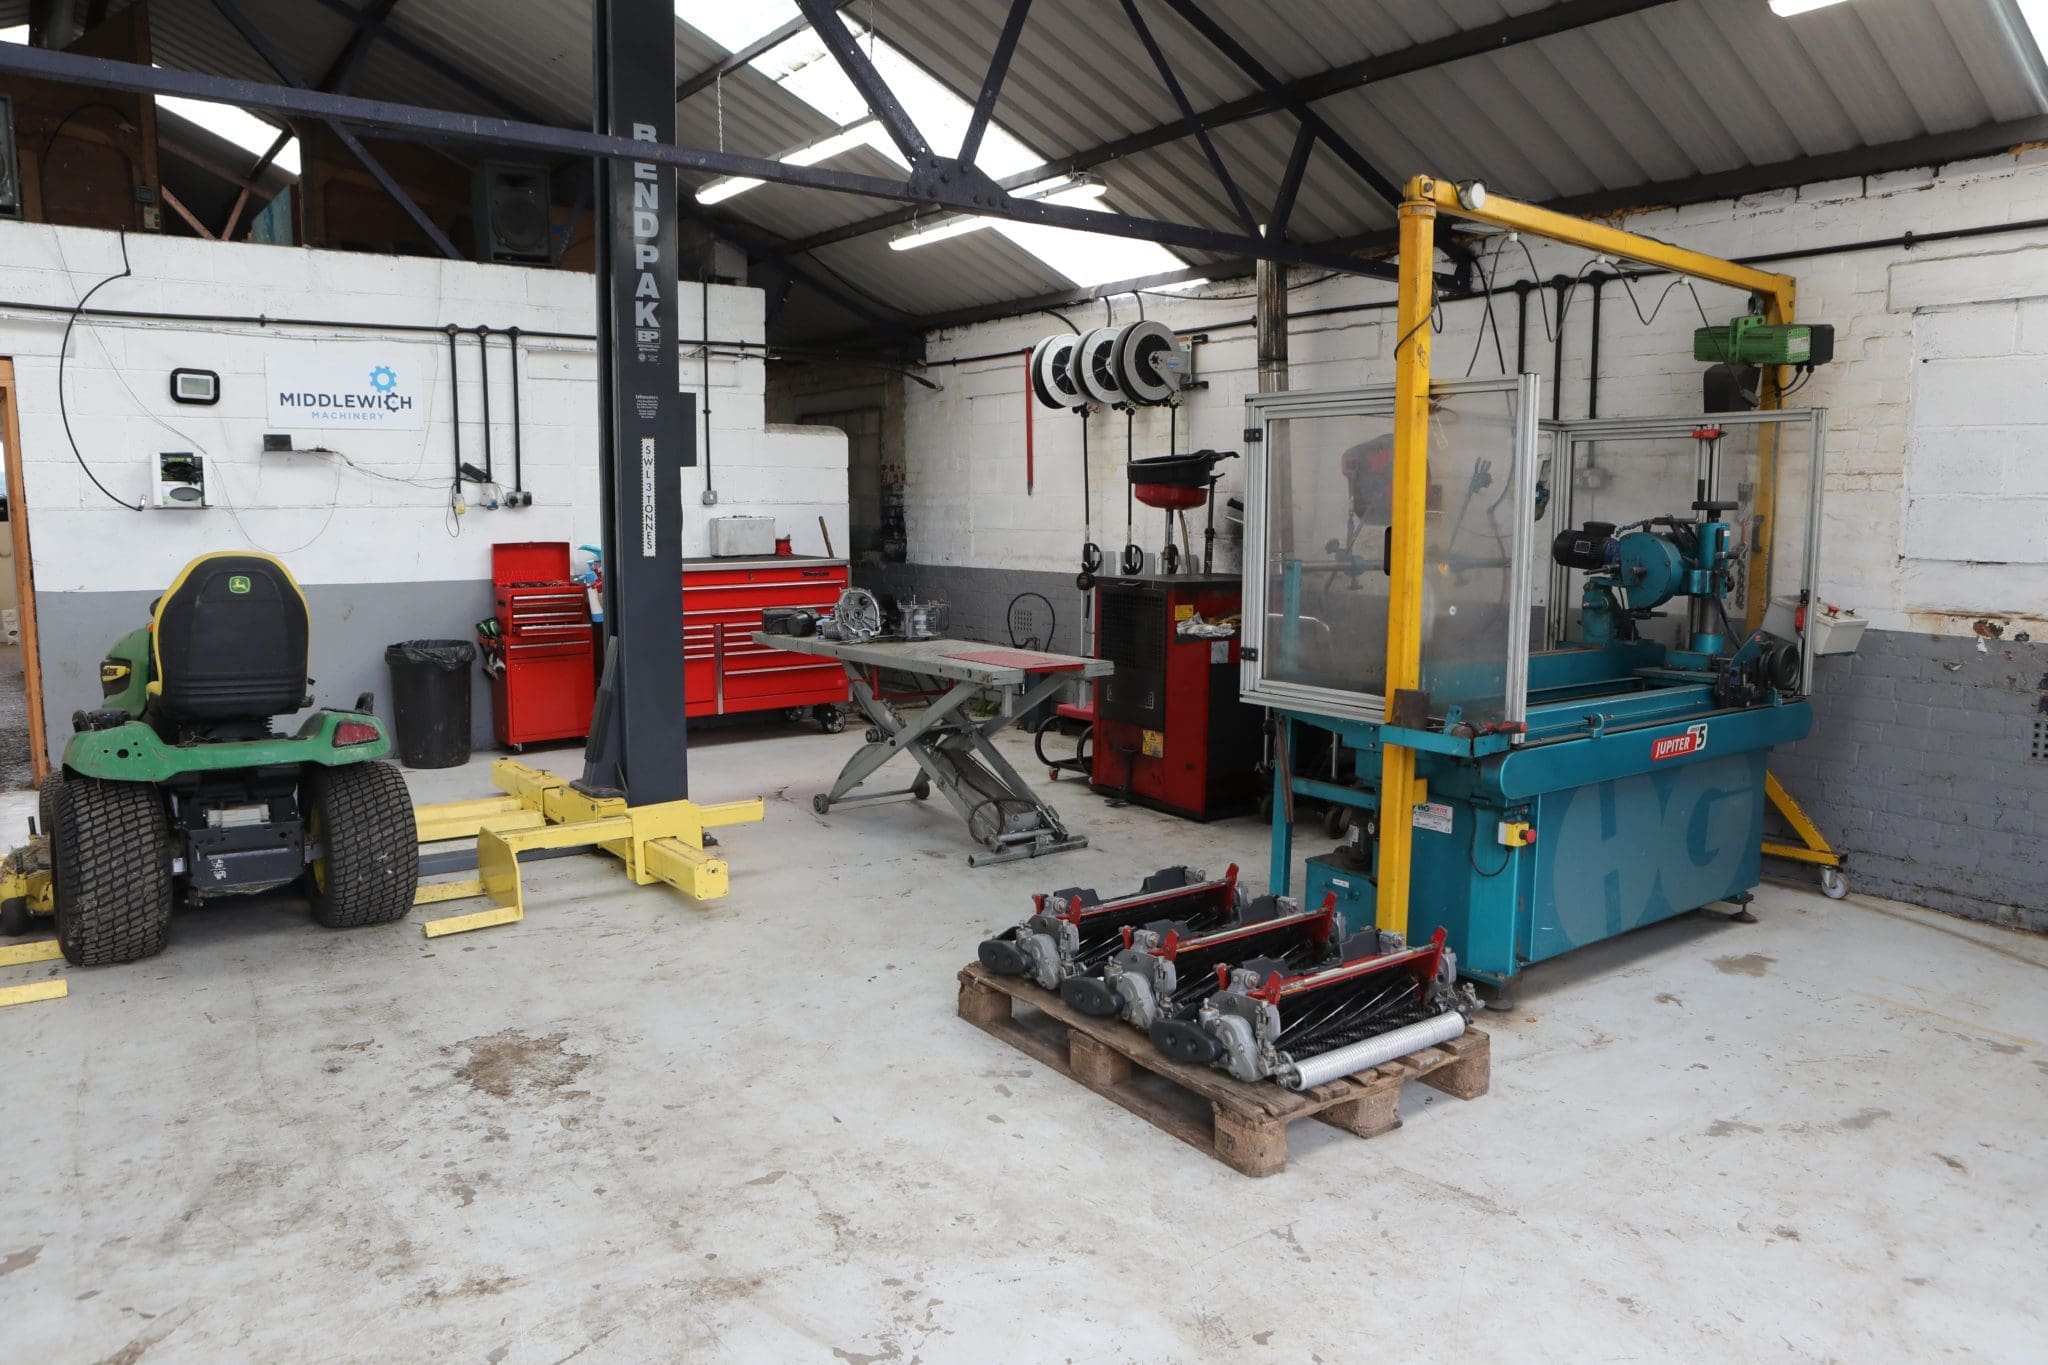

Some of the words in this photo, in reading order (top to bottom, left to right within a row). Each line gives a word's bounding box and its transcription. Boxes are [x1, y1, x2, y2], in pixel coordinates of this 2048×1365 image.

[280, 392, 412, 412] MIDDLEWICH
[311, 411, 384, 420] MACHINERY
[645, 482, 652, 492] 3
[644, 495, 654, 550] TONNES
[1655, 736, 1690, 759] JUPITER
[1696, 725, 1707, 749] 5
